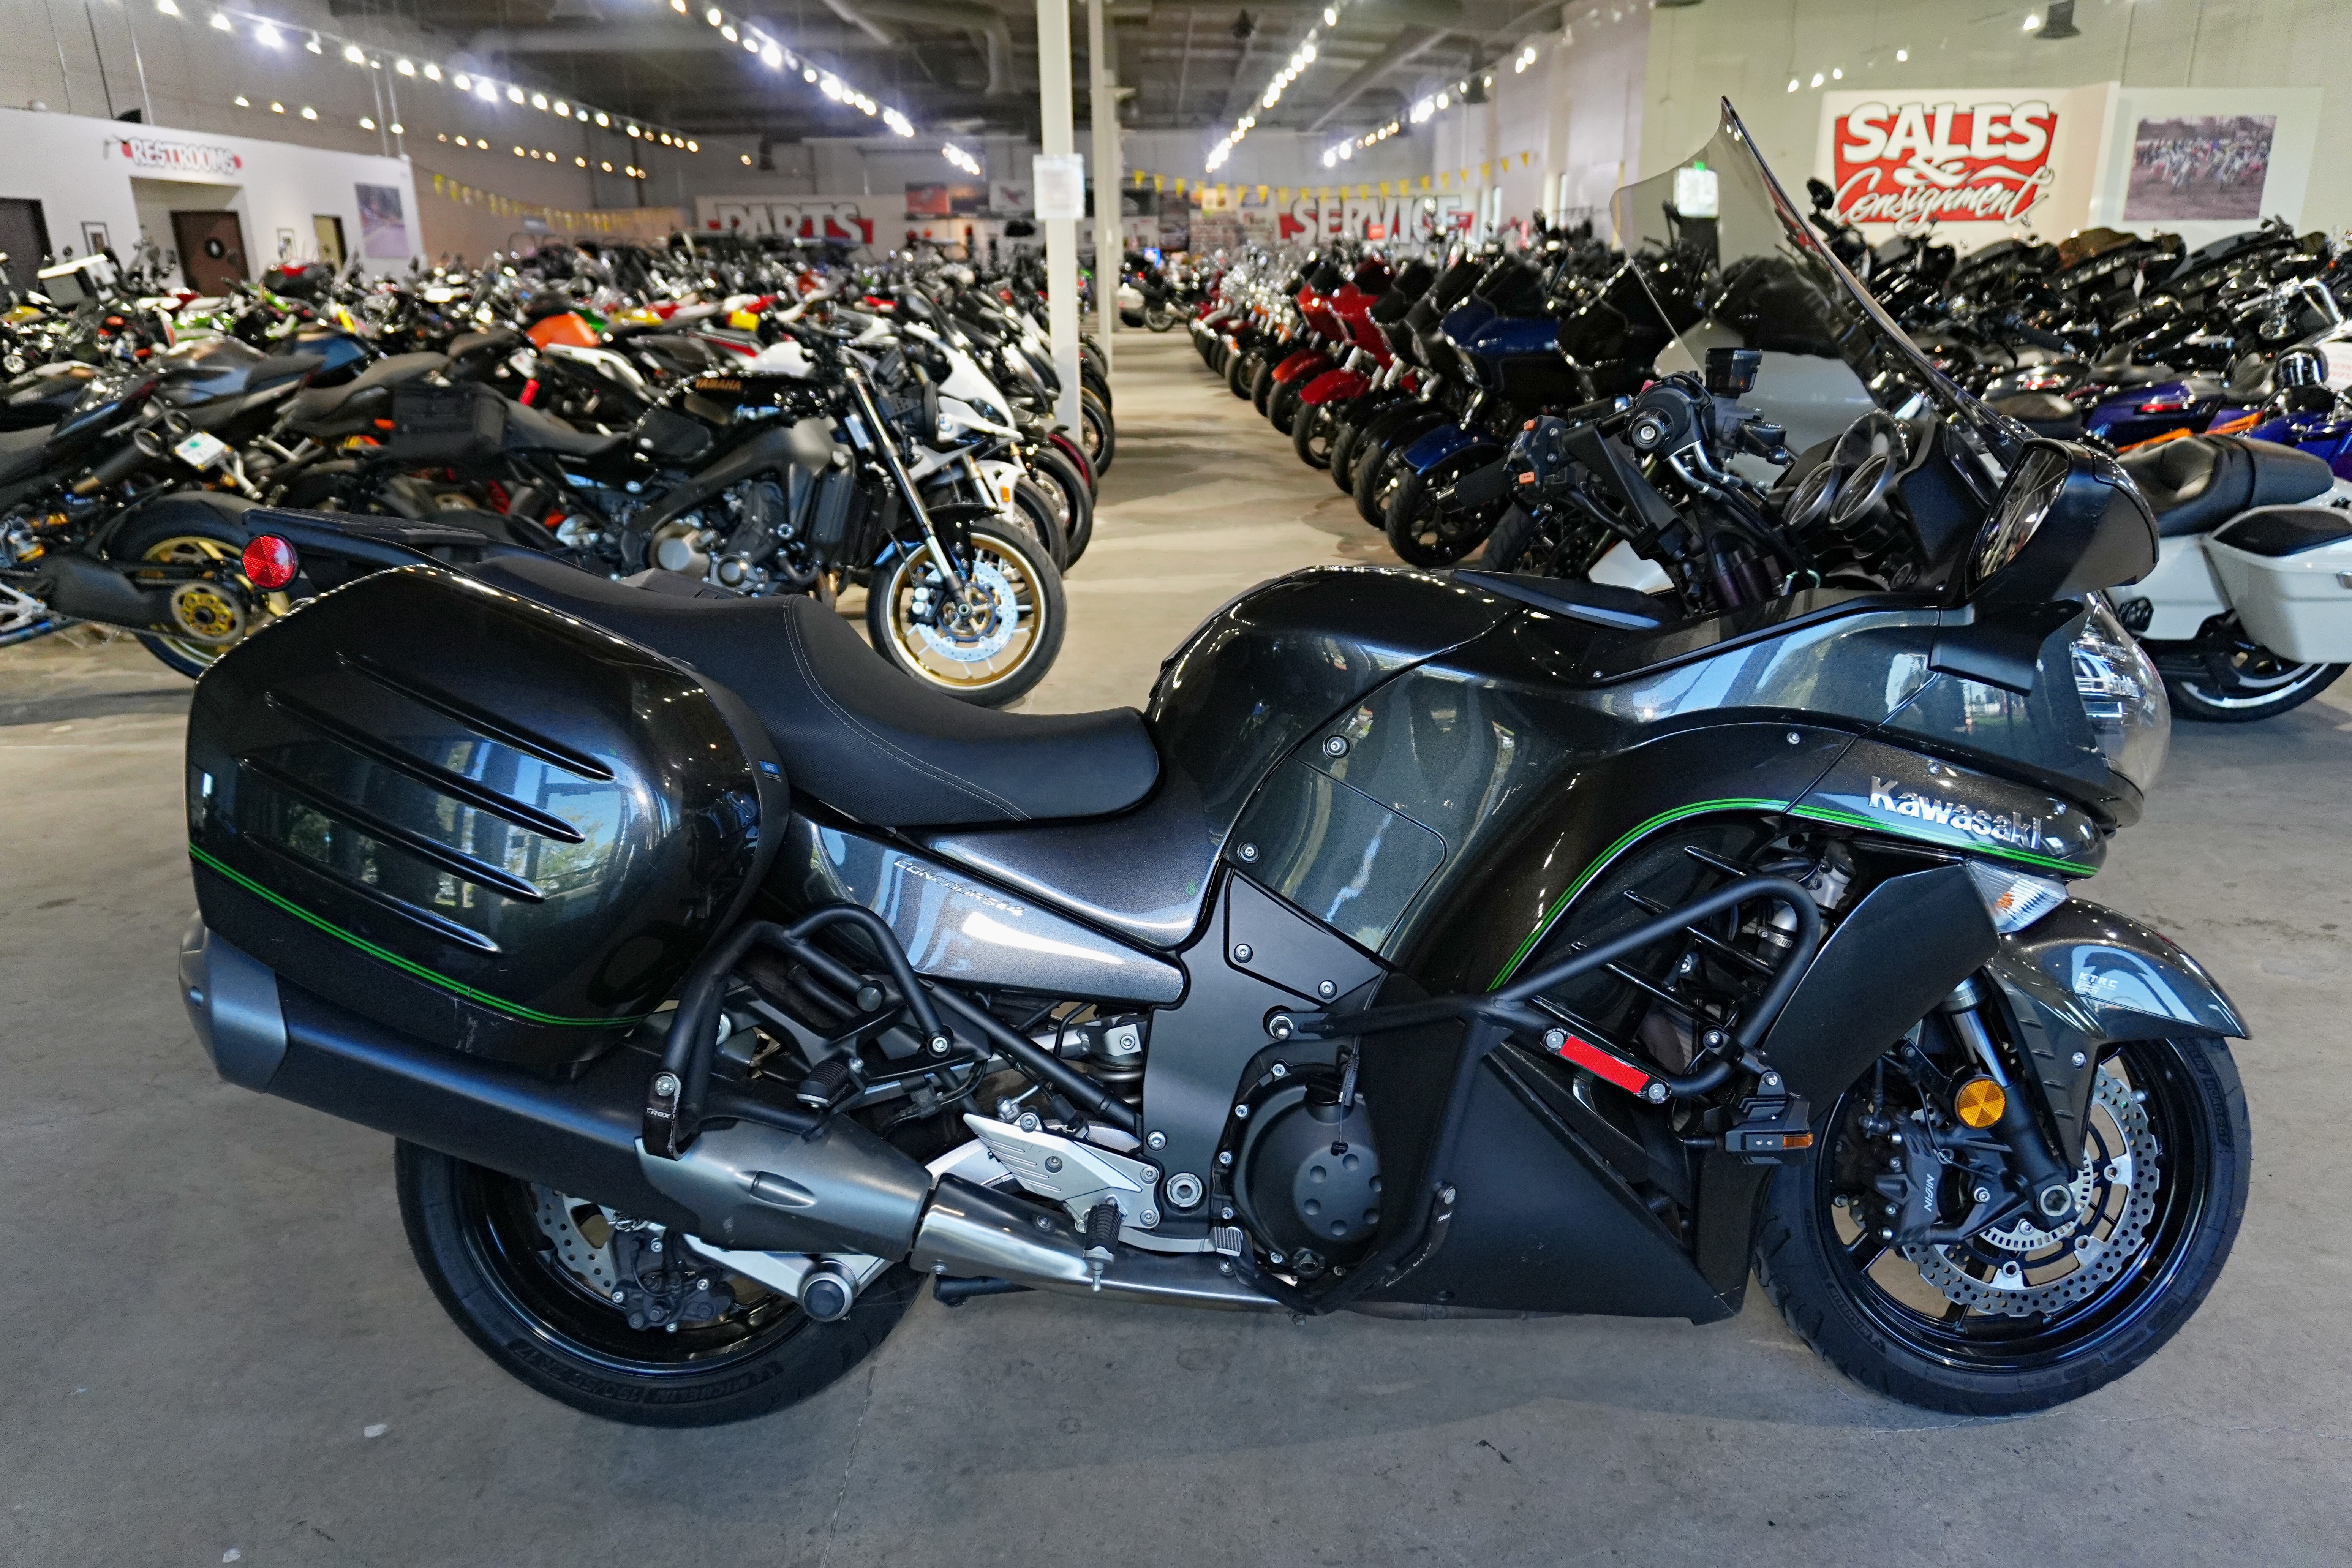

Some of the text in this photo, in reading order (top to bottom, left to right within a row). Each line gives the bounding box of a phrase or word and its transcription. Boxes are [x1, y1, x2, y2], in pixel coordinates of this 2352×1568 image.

[1843, 100, 2049, 163] SALES
[129, 137, 236, 175] RESTROOMS
[1832, 163, 2054, 235] Consignment
[715, 202, 865, 242] PARTS
[1291, 195, 1462, 249] SERVICE
[695, 379, 741, 390] YAMAHA
[1868, 776, 2041, 849] Kawasaki
[646, 1108, 671, 1119] T-Rex
[1924, 1173, 1934, 1212] NISSIN
[1829, 1287, 1871, 1336] MICHELIN
[514, 1345, 539, 1362] 17
[568, 1372, 637, 1402] 190/55
[654, 1376, 749, 1402] MICHELIN
